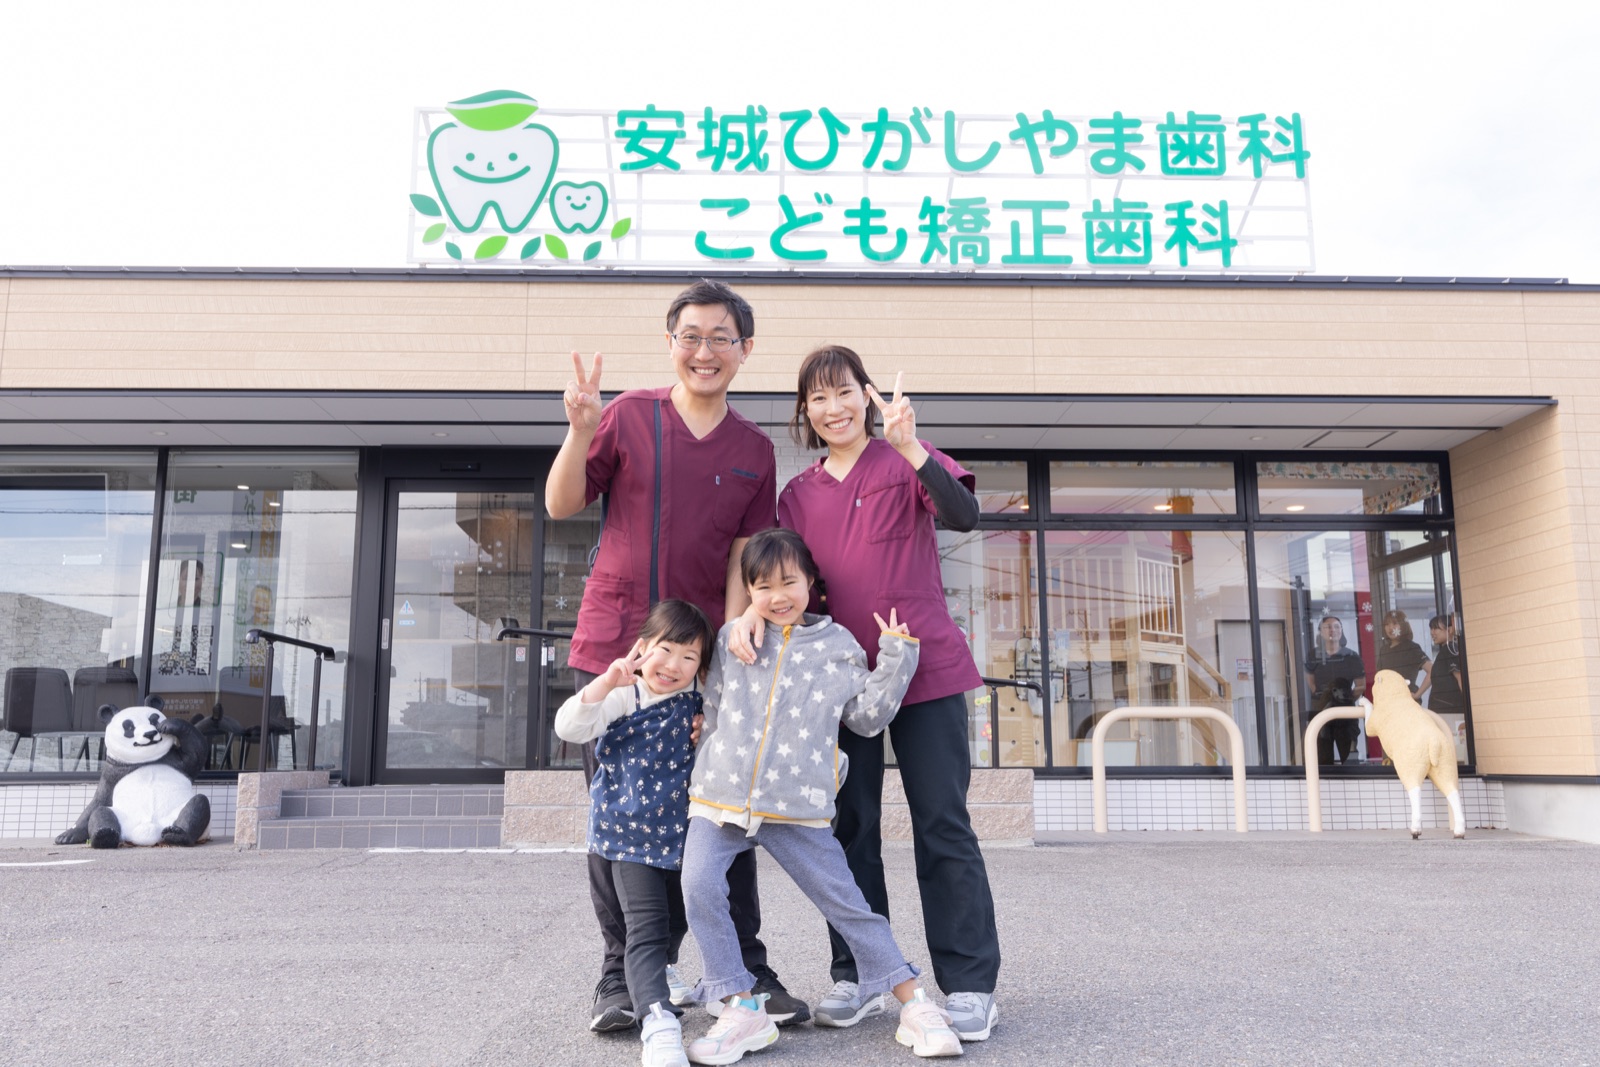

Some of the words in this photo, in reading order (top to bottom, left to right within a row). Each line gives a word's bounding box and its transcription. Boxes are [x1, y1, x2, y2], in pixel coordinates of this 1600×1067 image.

[615, 104, 1310, 178] 安城ひがしやま歯科
[695, 192, 1238, 267] こども矯正歯科
